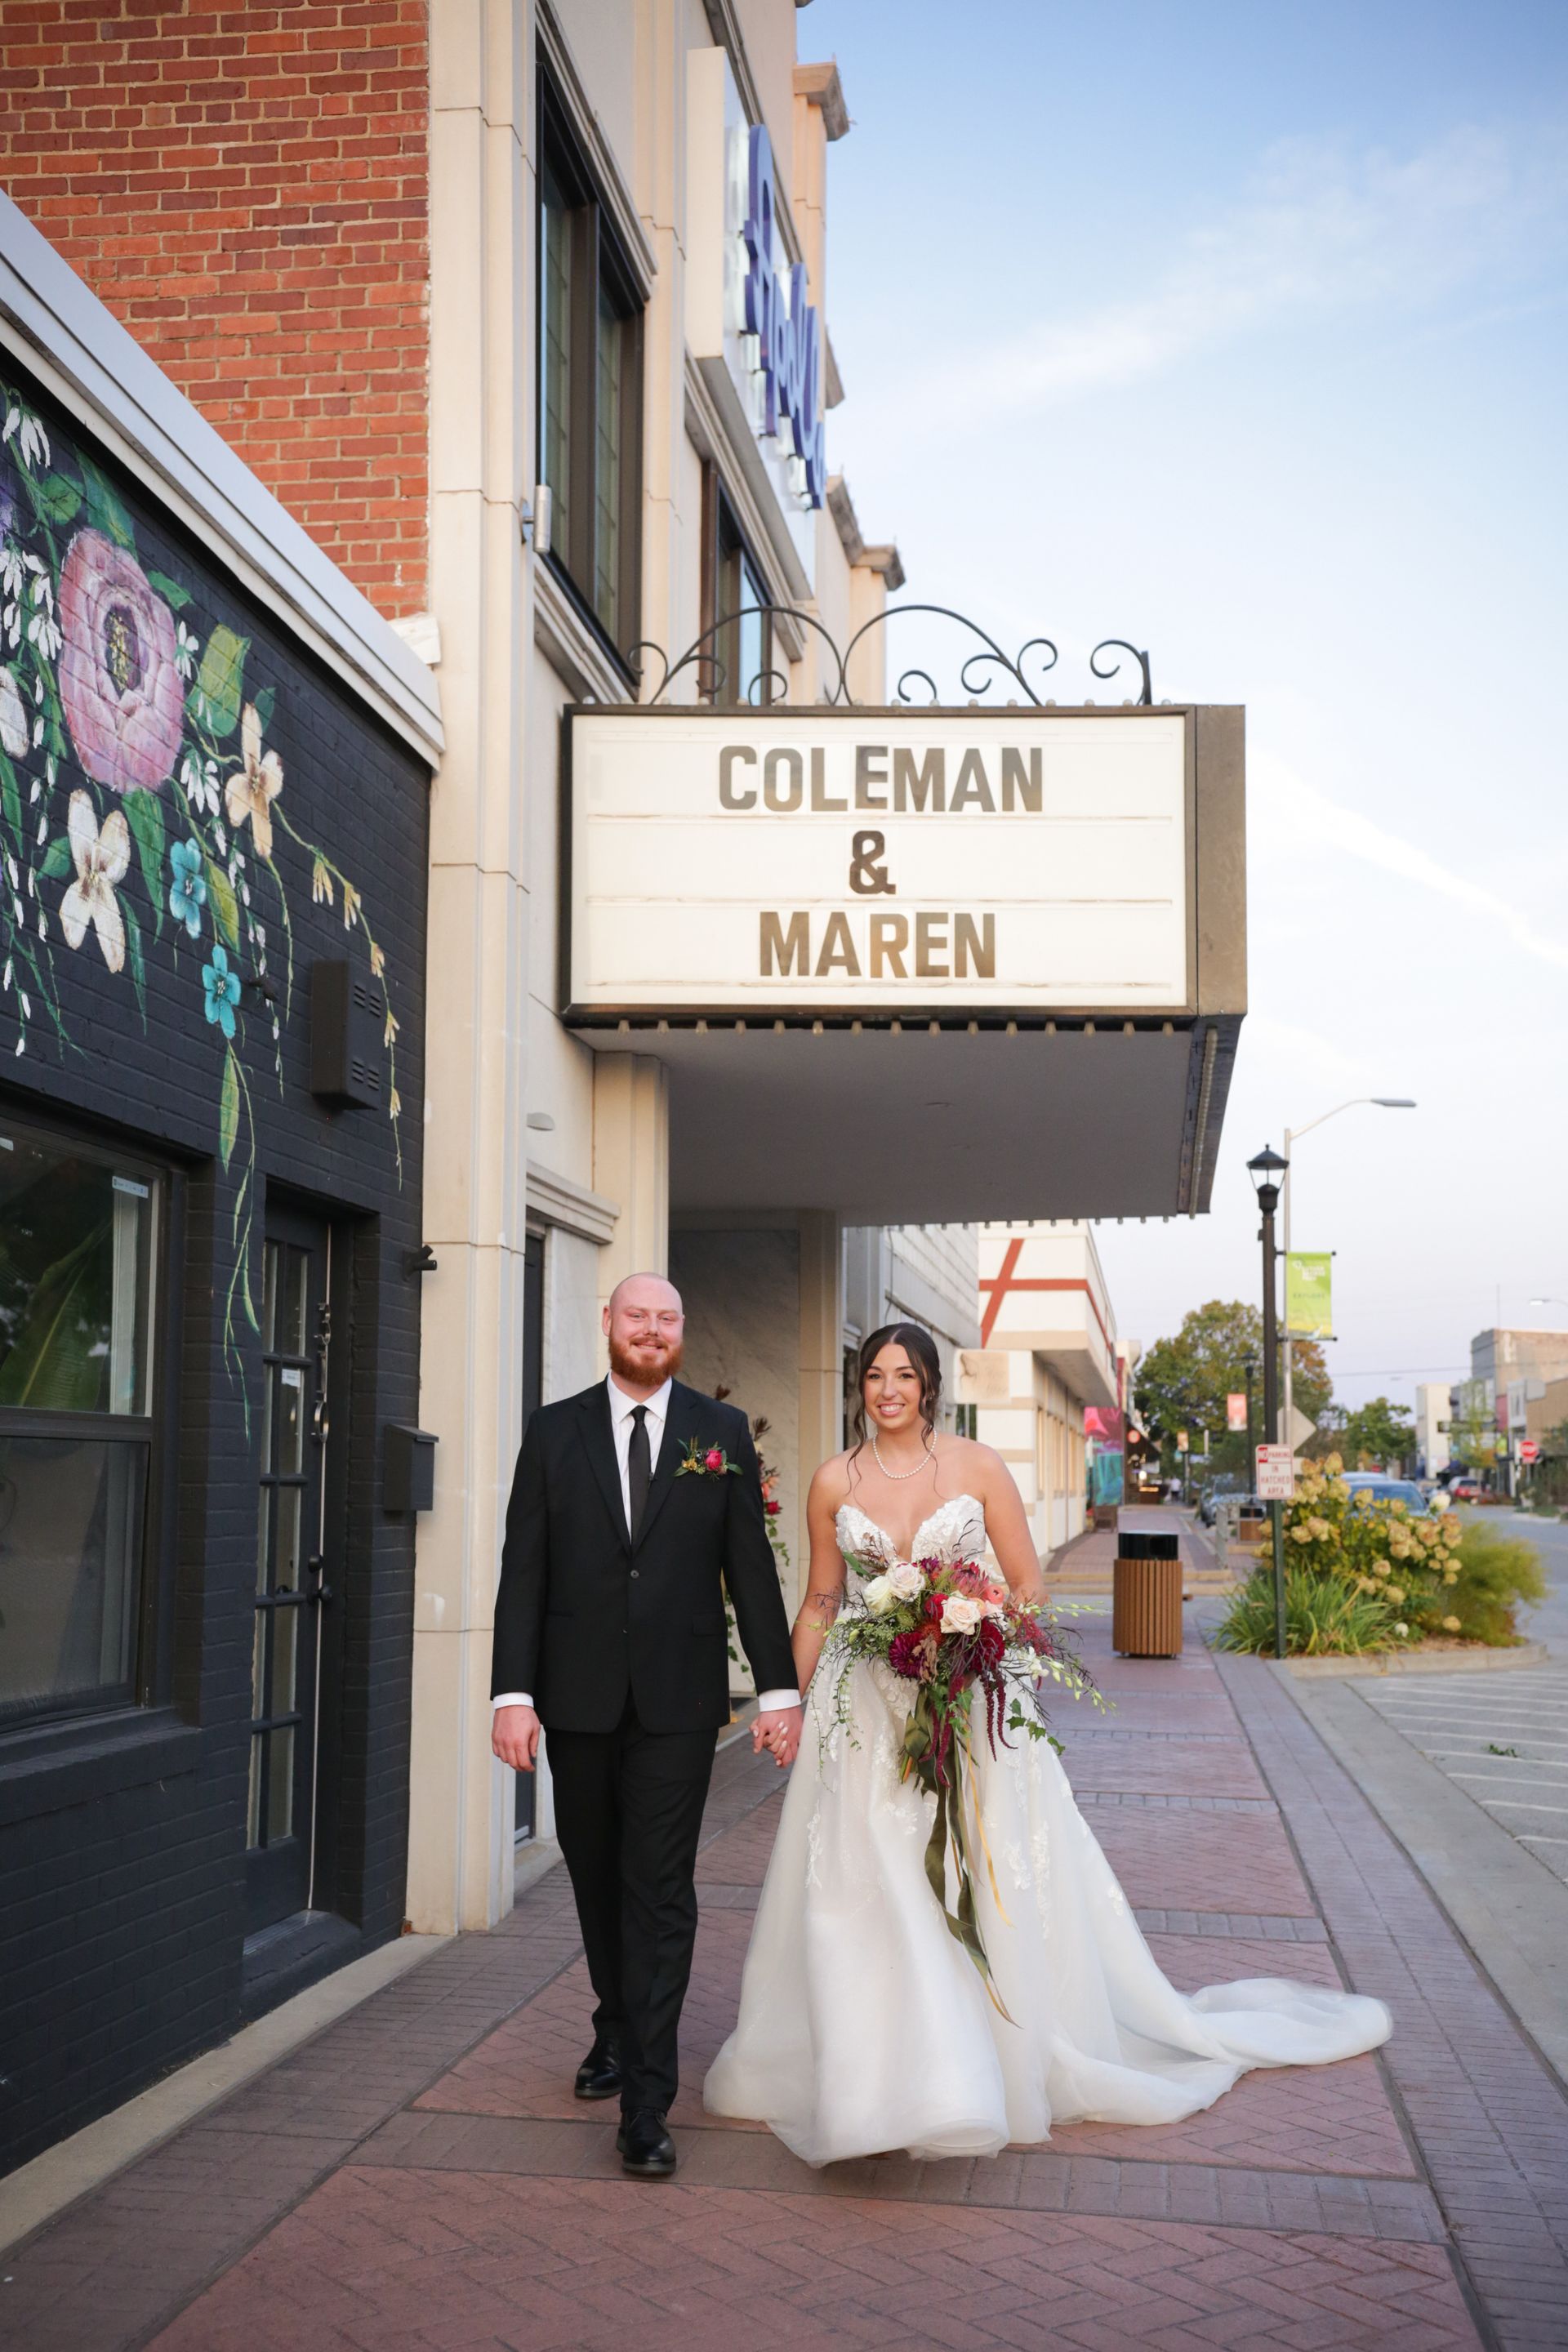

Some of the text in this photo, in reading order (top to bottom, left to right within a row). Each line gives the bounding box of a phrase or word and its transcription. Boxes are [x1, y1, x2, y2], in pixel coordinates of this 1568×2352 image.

[719, 745, 1043, 812] COLEMAN
[849, 830, 896, 894] &
[760, 911, 996, 978] MAREN
[1261, 1476, 1290, 1485] HATCHED
[1267, 1486, 1284, 1495] AREA
